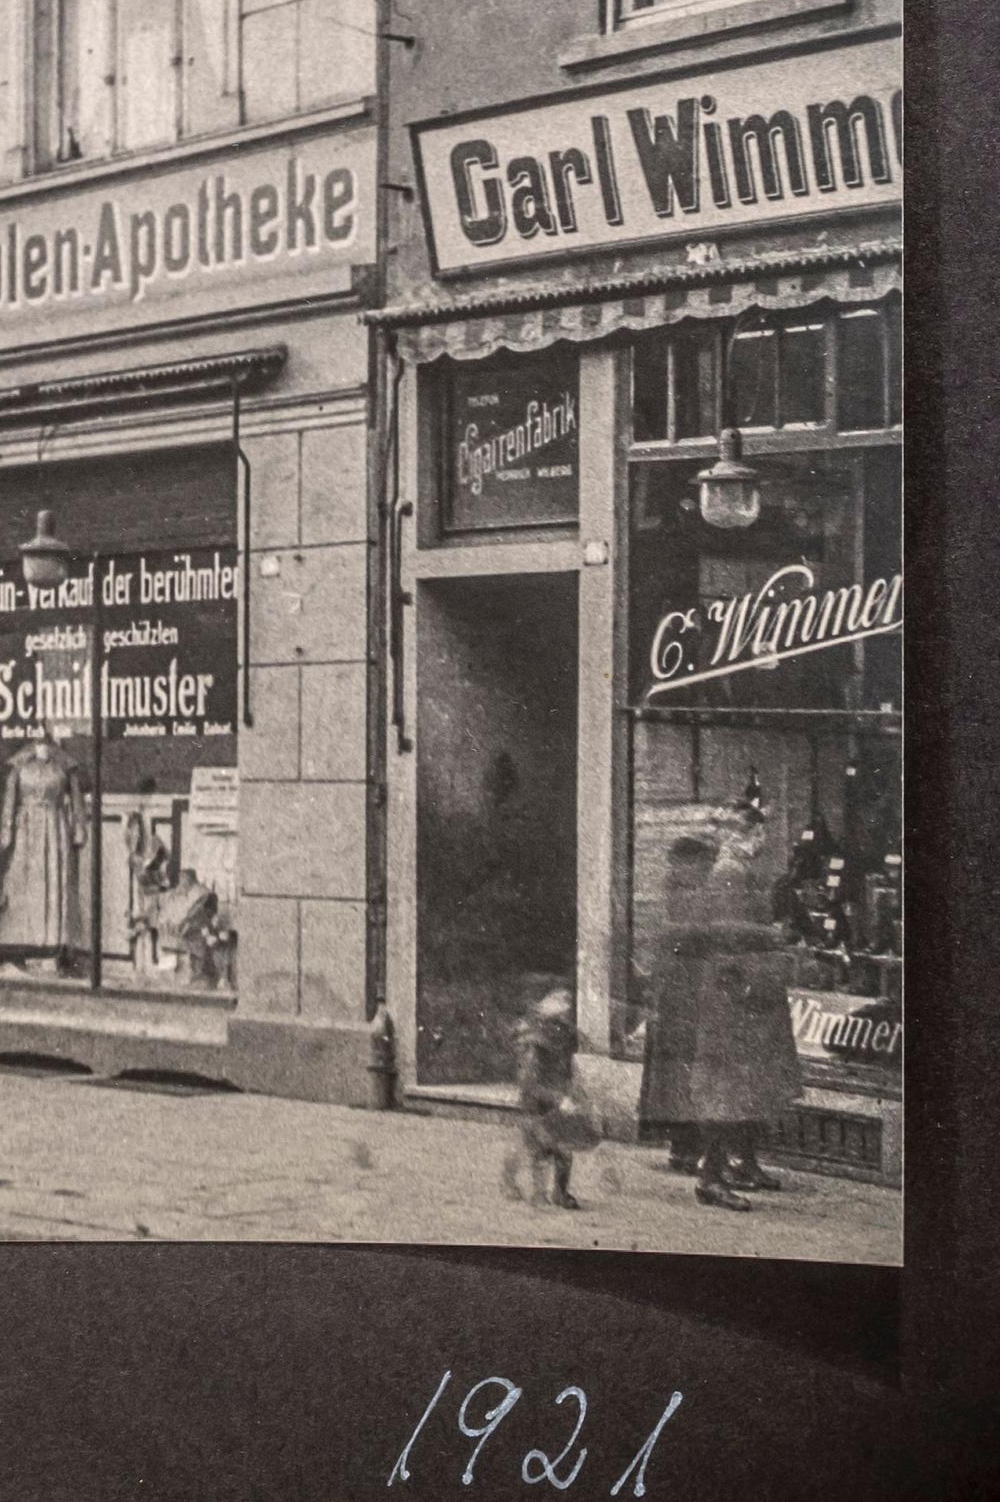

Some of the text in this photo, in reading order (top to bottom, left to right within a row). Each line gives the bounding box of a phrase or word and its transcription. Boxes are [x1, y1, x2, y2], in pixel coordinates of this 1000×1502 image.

[449, 88, 903, 247] Carl Wimm
[102, 560, 133, 606] der
[388, 1369, 684, 1497] 1921
